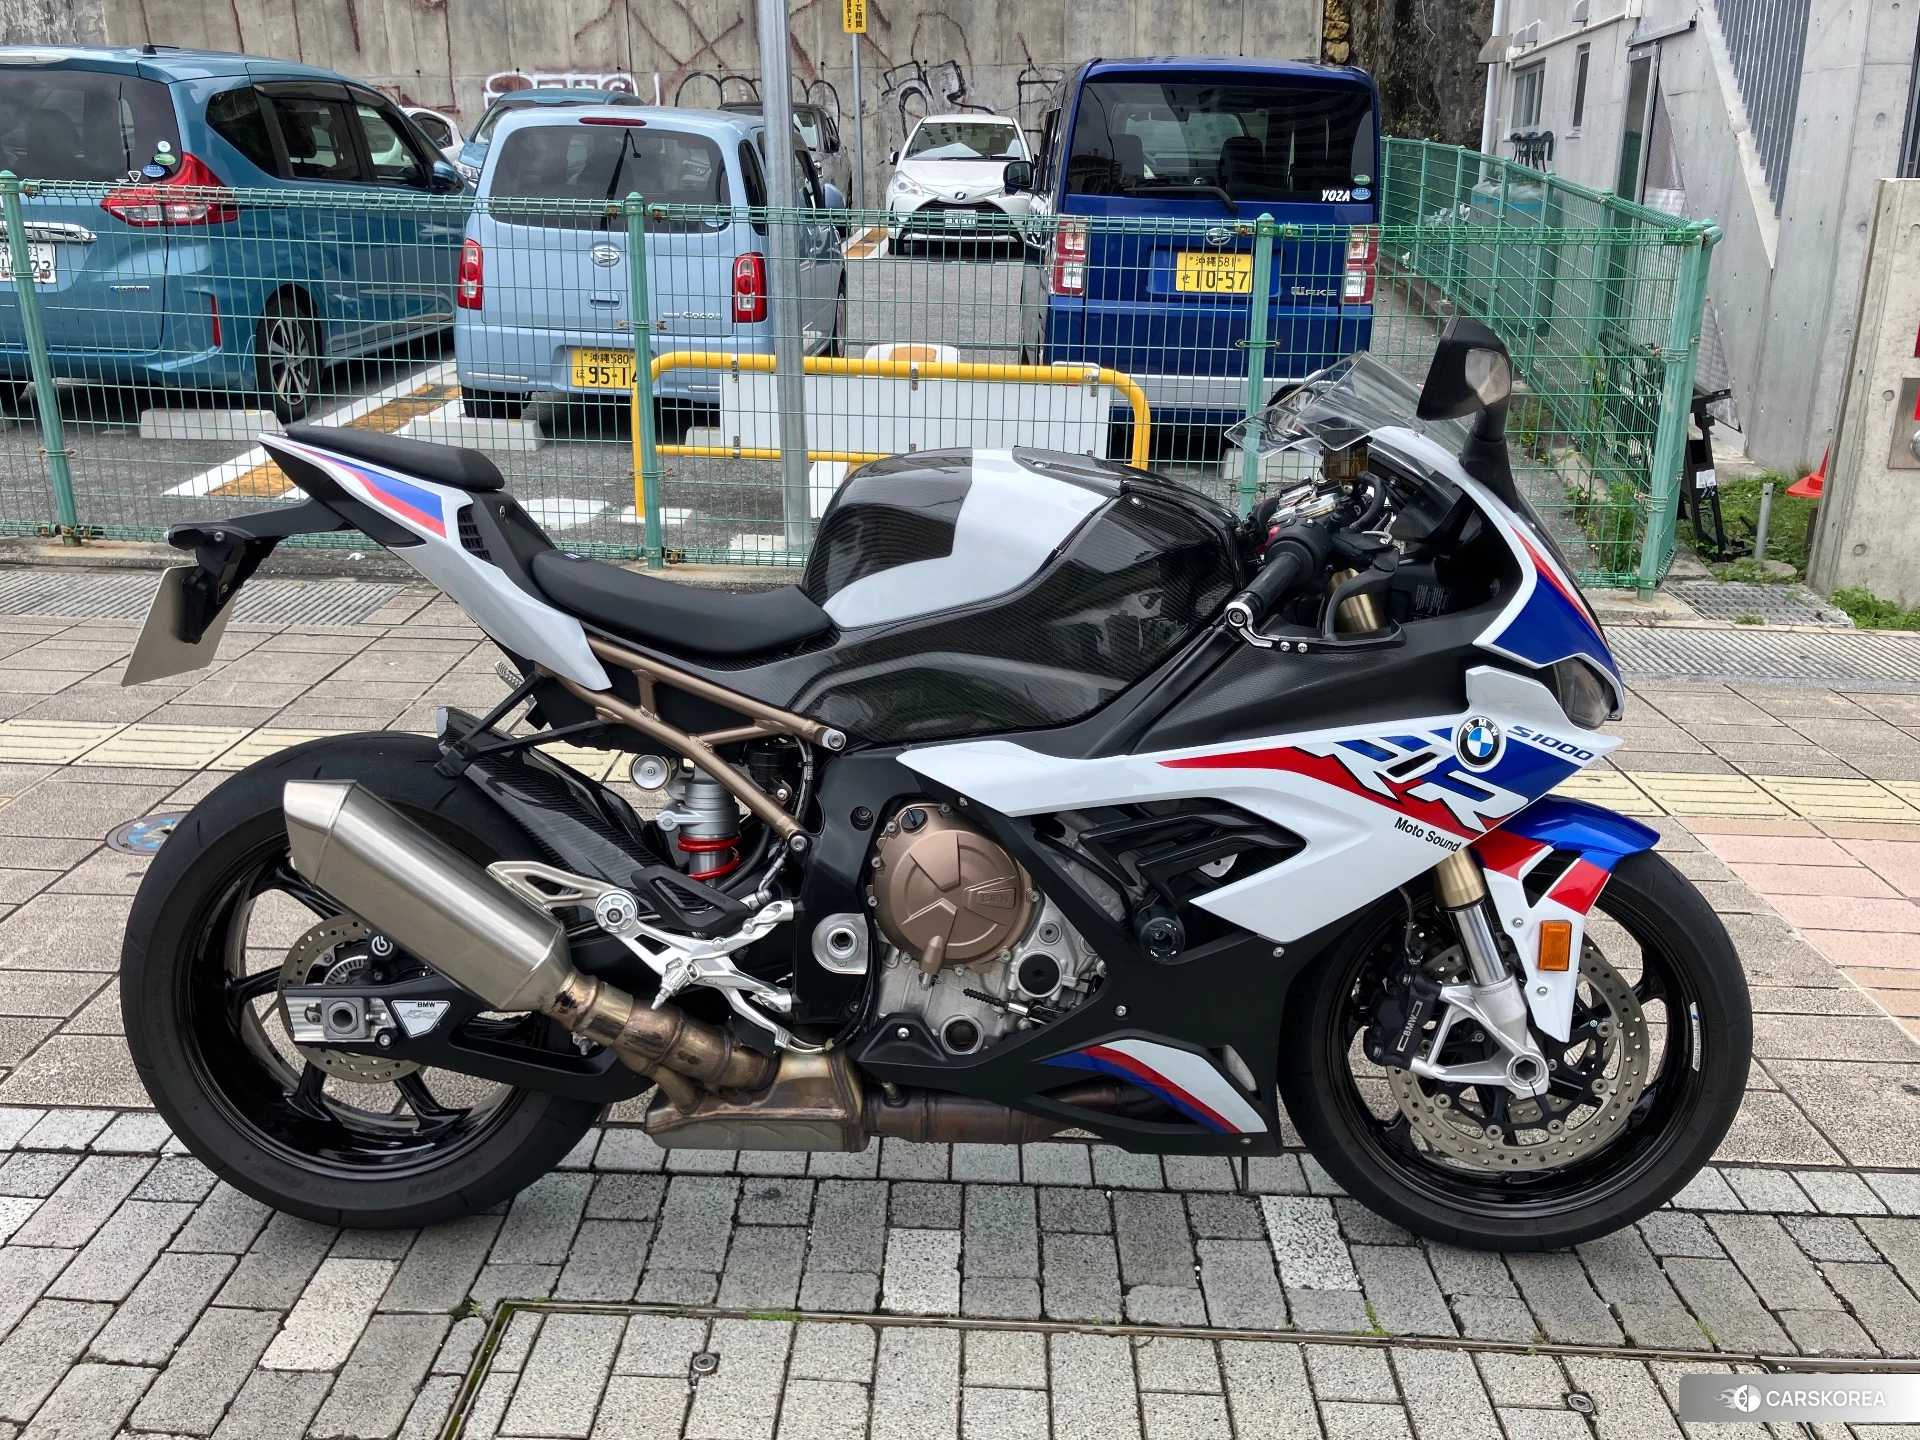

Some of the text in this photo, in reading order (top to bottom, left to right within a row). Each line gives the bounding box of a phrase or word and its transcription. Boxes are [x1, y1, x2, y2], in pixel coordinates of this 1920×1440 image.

[1321, 189, 1351, 202] YOZA
[1195, 256, 1235, 268] 沖縄581
[1196, 270, 1248, 290] 10-57
[589, 352, 629, 365] 沖縄580
[1506, 725, 1595, 761] S1000
[1394, 816, 1462, 853] Moto Sound
[1403, 1014, 1418, 1037] BMW
